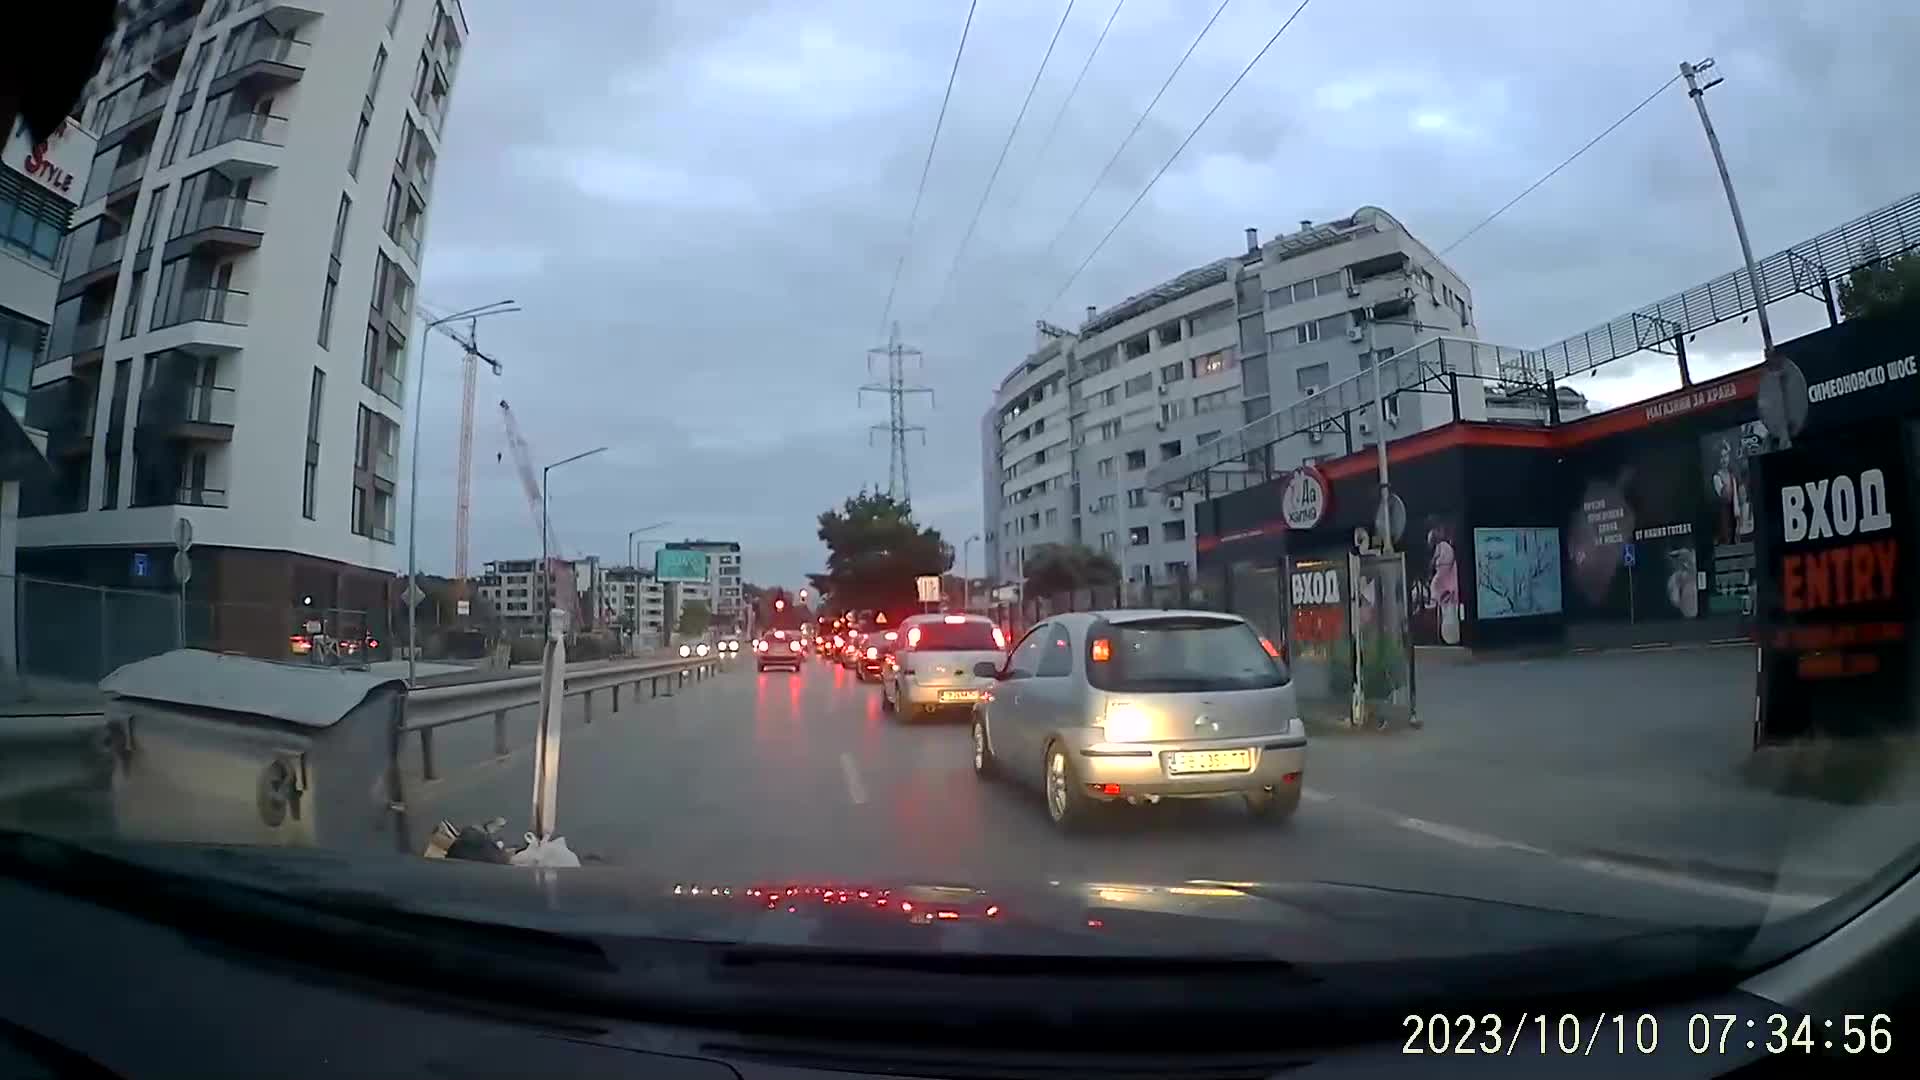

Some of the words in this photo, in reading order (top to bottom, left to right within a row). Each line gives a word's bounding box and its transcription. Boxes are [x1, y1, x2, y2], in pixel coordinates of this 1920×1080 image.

[1693, 391, 1705, 407] ЗА
[1808, 366, 1886, 403] СИМЕОНОВСКО
[1887, 355, 1918, 381] ШОСЕ
[1781, 468, 1892, 543] ВХОД
[1291, 569, 1341, 605] ВХОД
[1783, 538, 1898, 611] ENTRY
